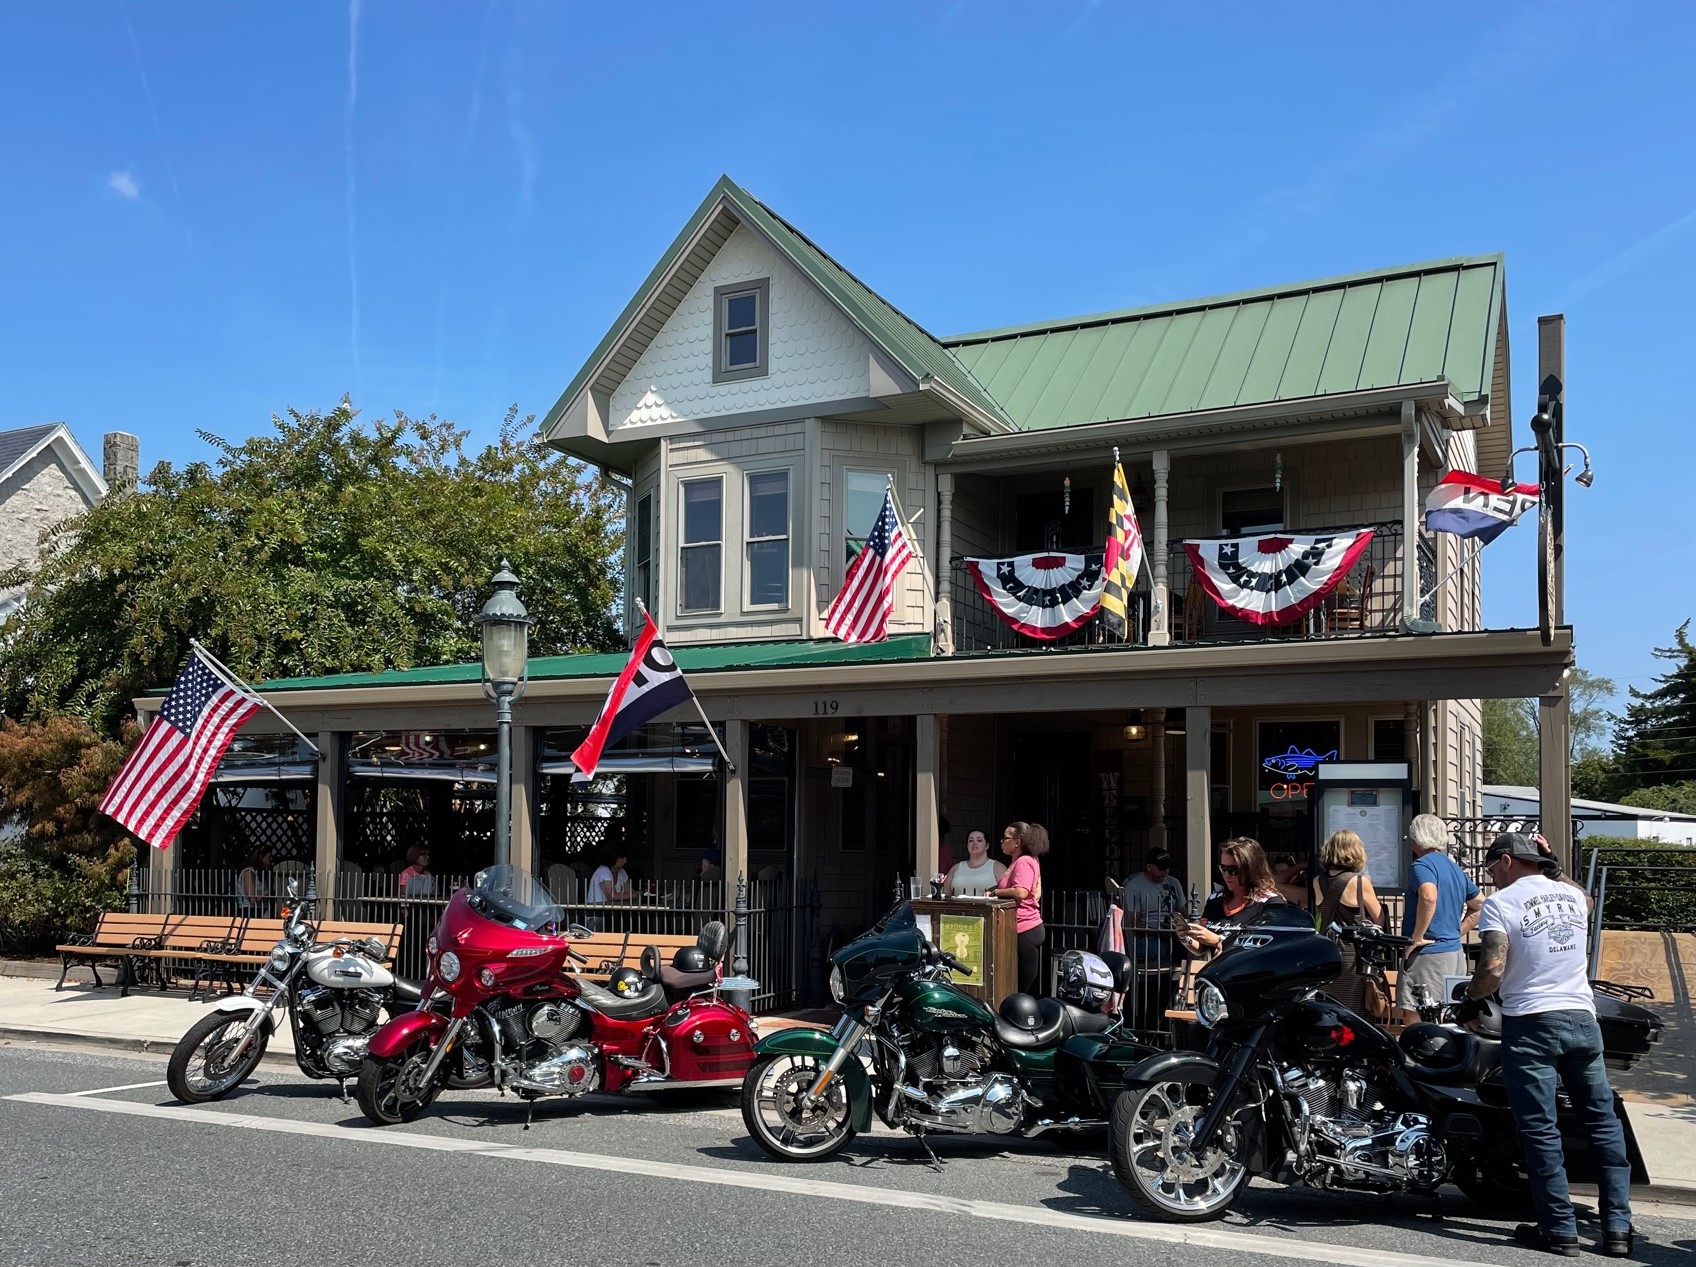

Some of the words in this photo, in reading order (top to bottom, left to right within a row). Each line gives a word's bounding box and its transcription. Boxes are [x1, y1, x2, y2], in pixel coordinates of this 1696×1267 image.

[812, 700, 839, 715] 119
[1270, 782, 1316, 799] OPE
[1099, 772, 1121, 878] WELCOM
[1549, 944, 1576, 953] DELAWARE
